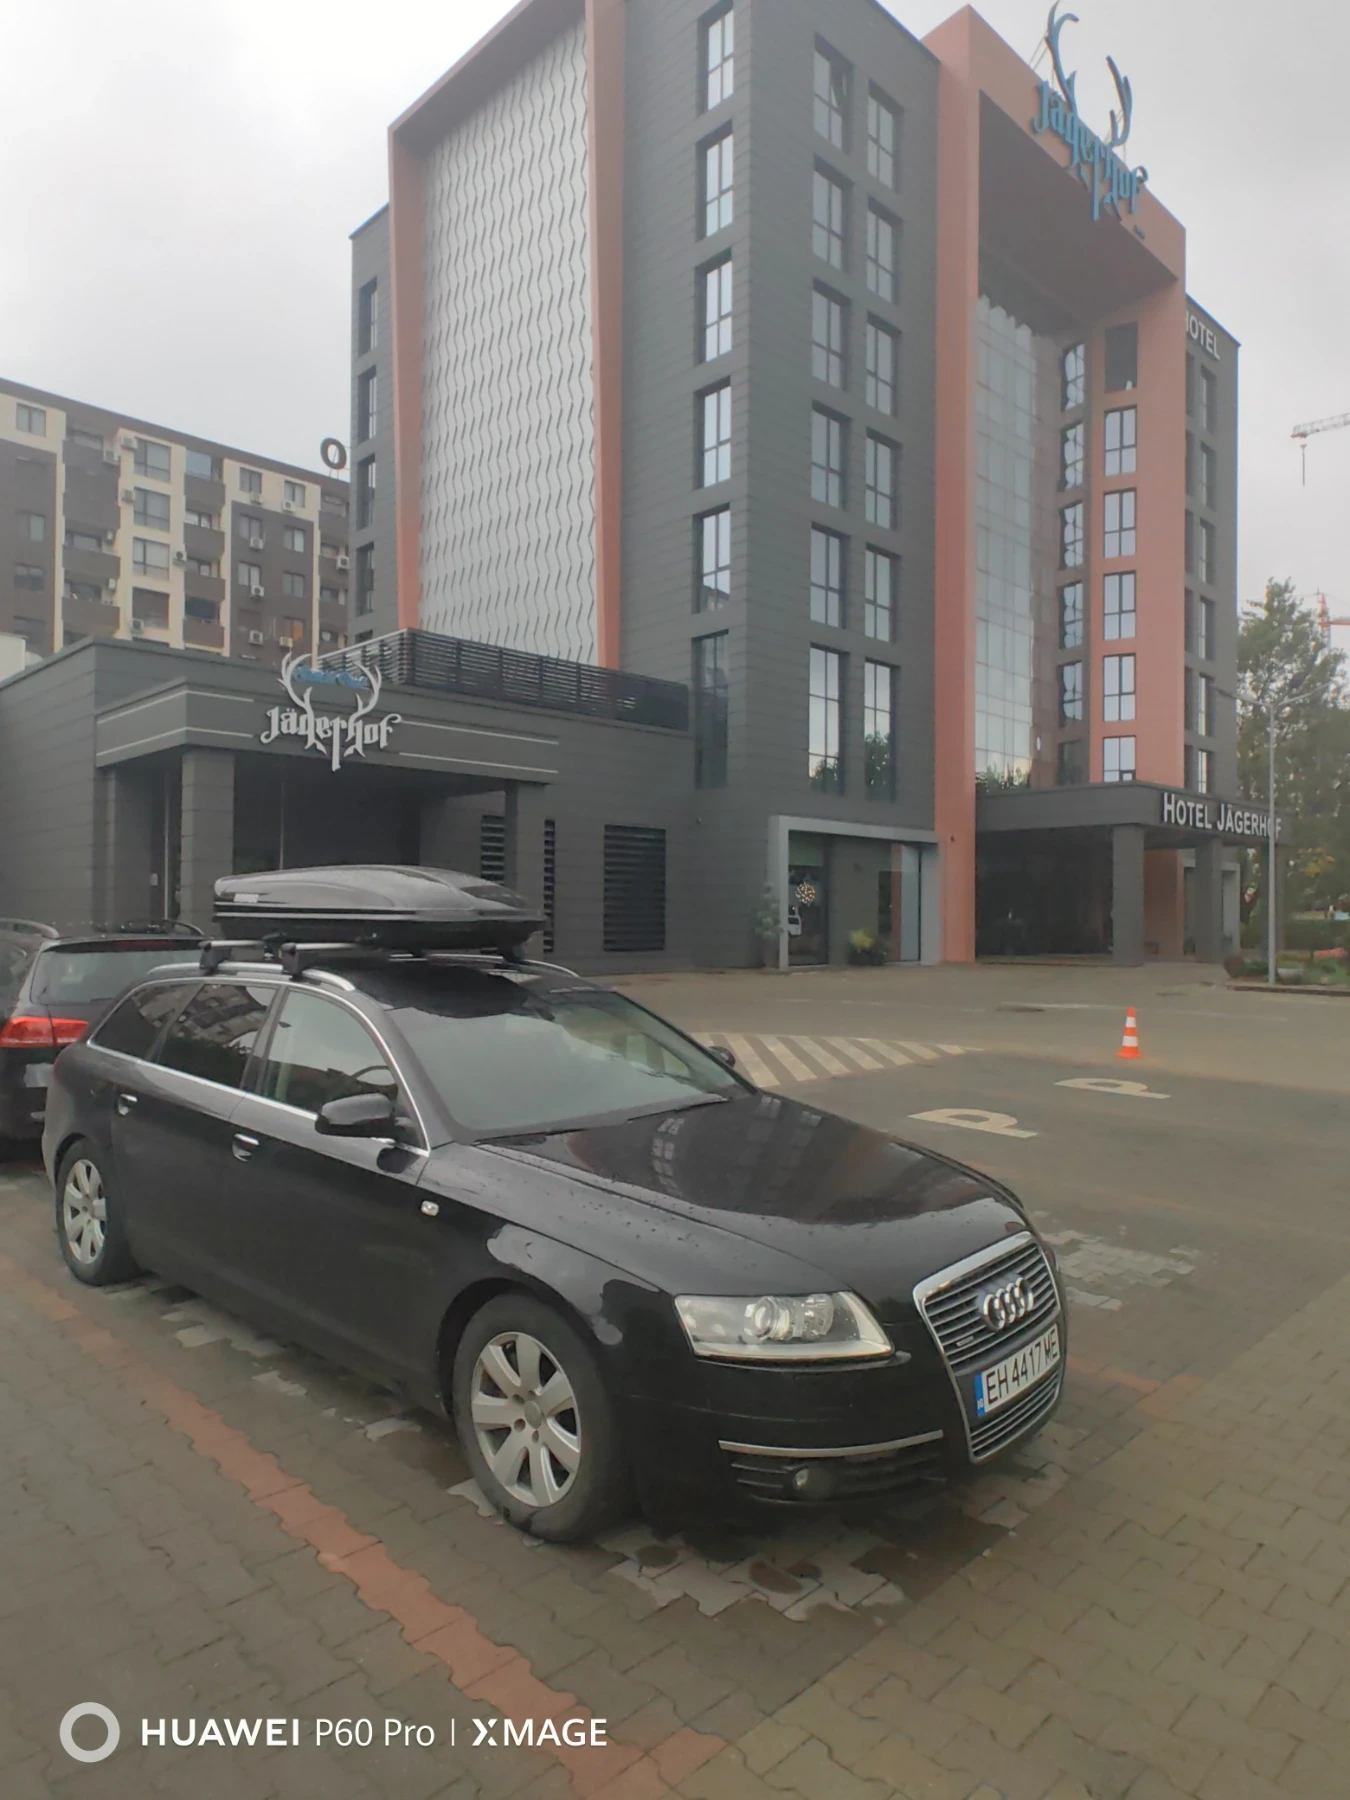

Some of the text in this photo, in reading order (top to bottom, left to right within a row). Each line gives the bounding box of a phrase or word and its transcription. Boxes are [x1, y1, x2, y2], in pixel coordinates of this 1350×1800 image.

[1163, 792, 1213, 830] HOTEL
[985, 1363, 1009, 1405] EH
[1011, 1341, 1041, 1388] 4417
